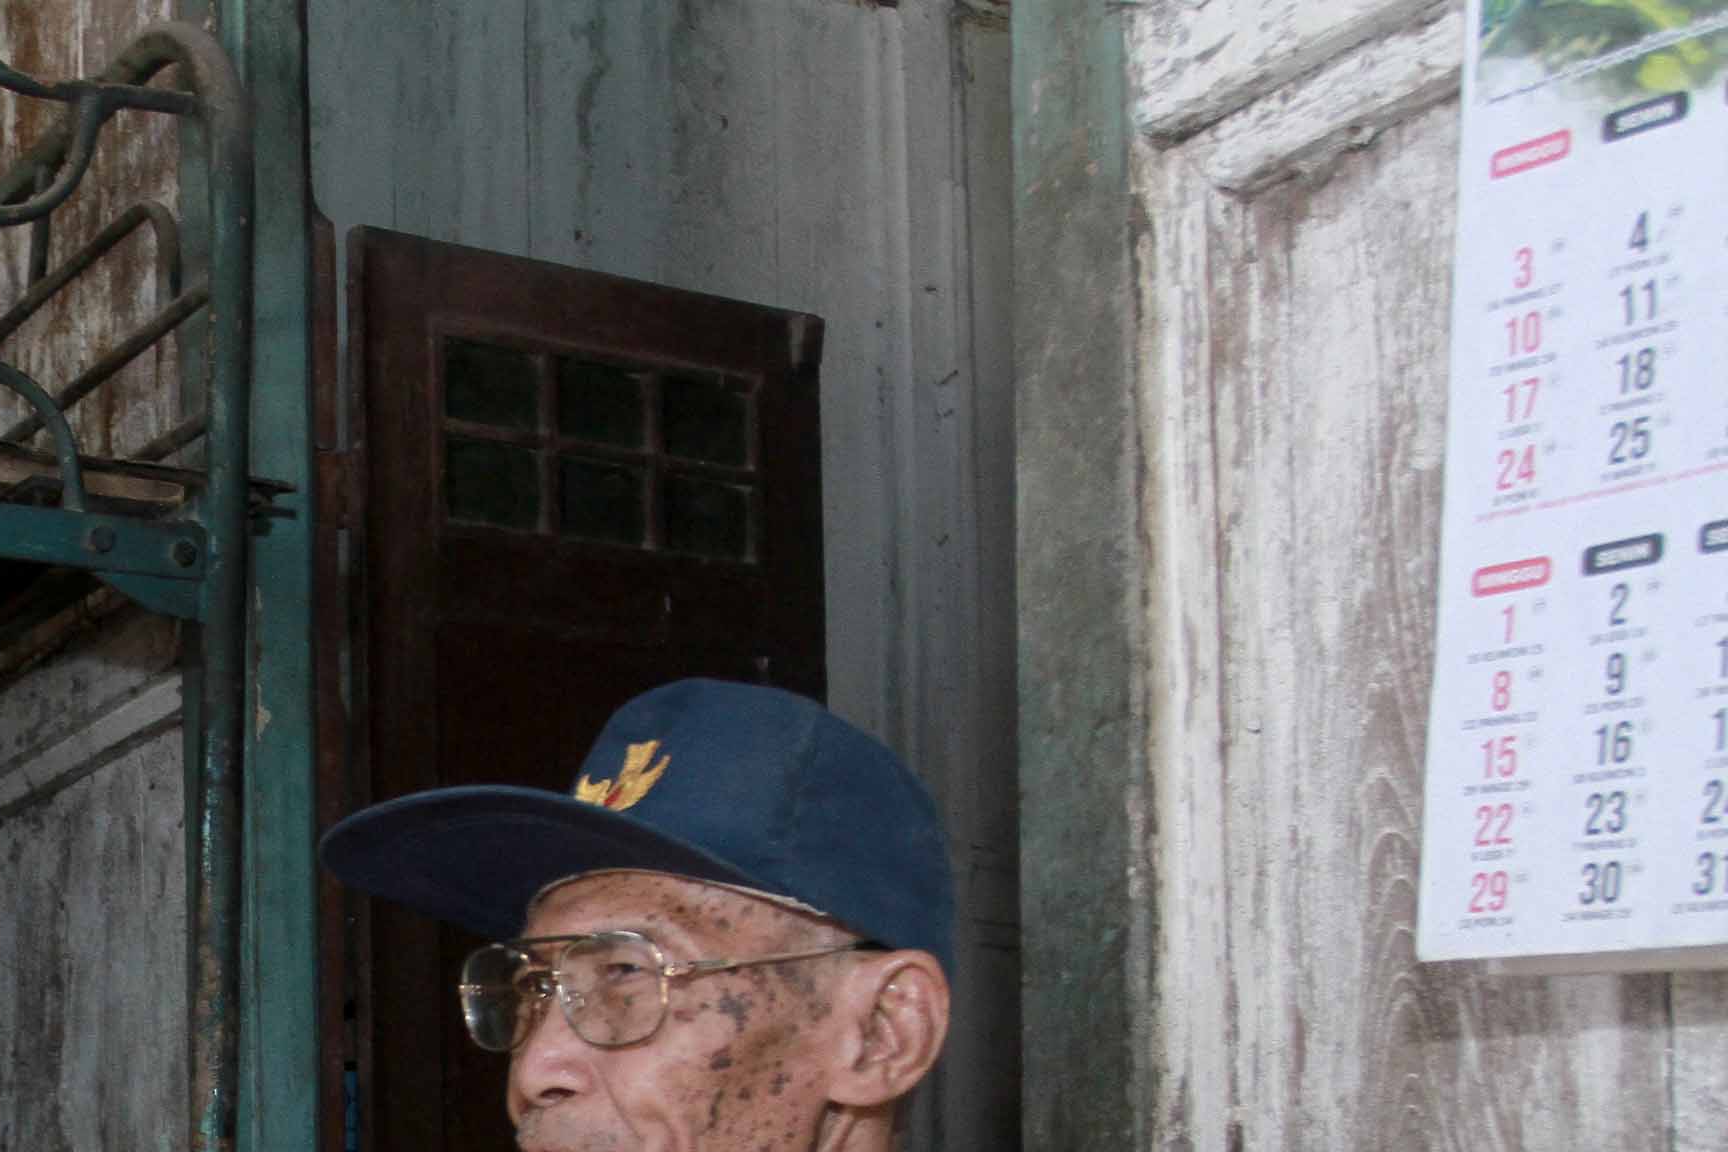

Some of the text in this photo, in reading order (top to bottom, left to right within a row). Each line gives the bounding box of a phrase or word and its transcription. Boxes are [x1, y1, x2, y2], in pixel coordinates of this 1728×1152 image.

[1513, 210, 1648, 289] 3 4
[1505, 311, 1540, 357] 10
[1620, 278, 1657, 326] 11
[1504, 347, 1655, 422] 17 18
[1496, 416, 1650, 491] 24 25
[1502, 583, 1629, 645] 1 2
[1492, 670, 1512, 712] 8
[1606, 653, 1625, 695] 9
[1481, 735, 1517, 779] 15
[1595, 720, 1632, 766] 16
[1475, 780, 1728, 847] 22 23 2
[1469, 870, 1508, 913] 29
[1579, 861, 1621, 904] 30
